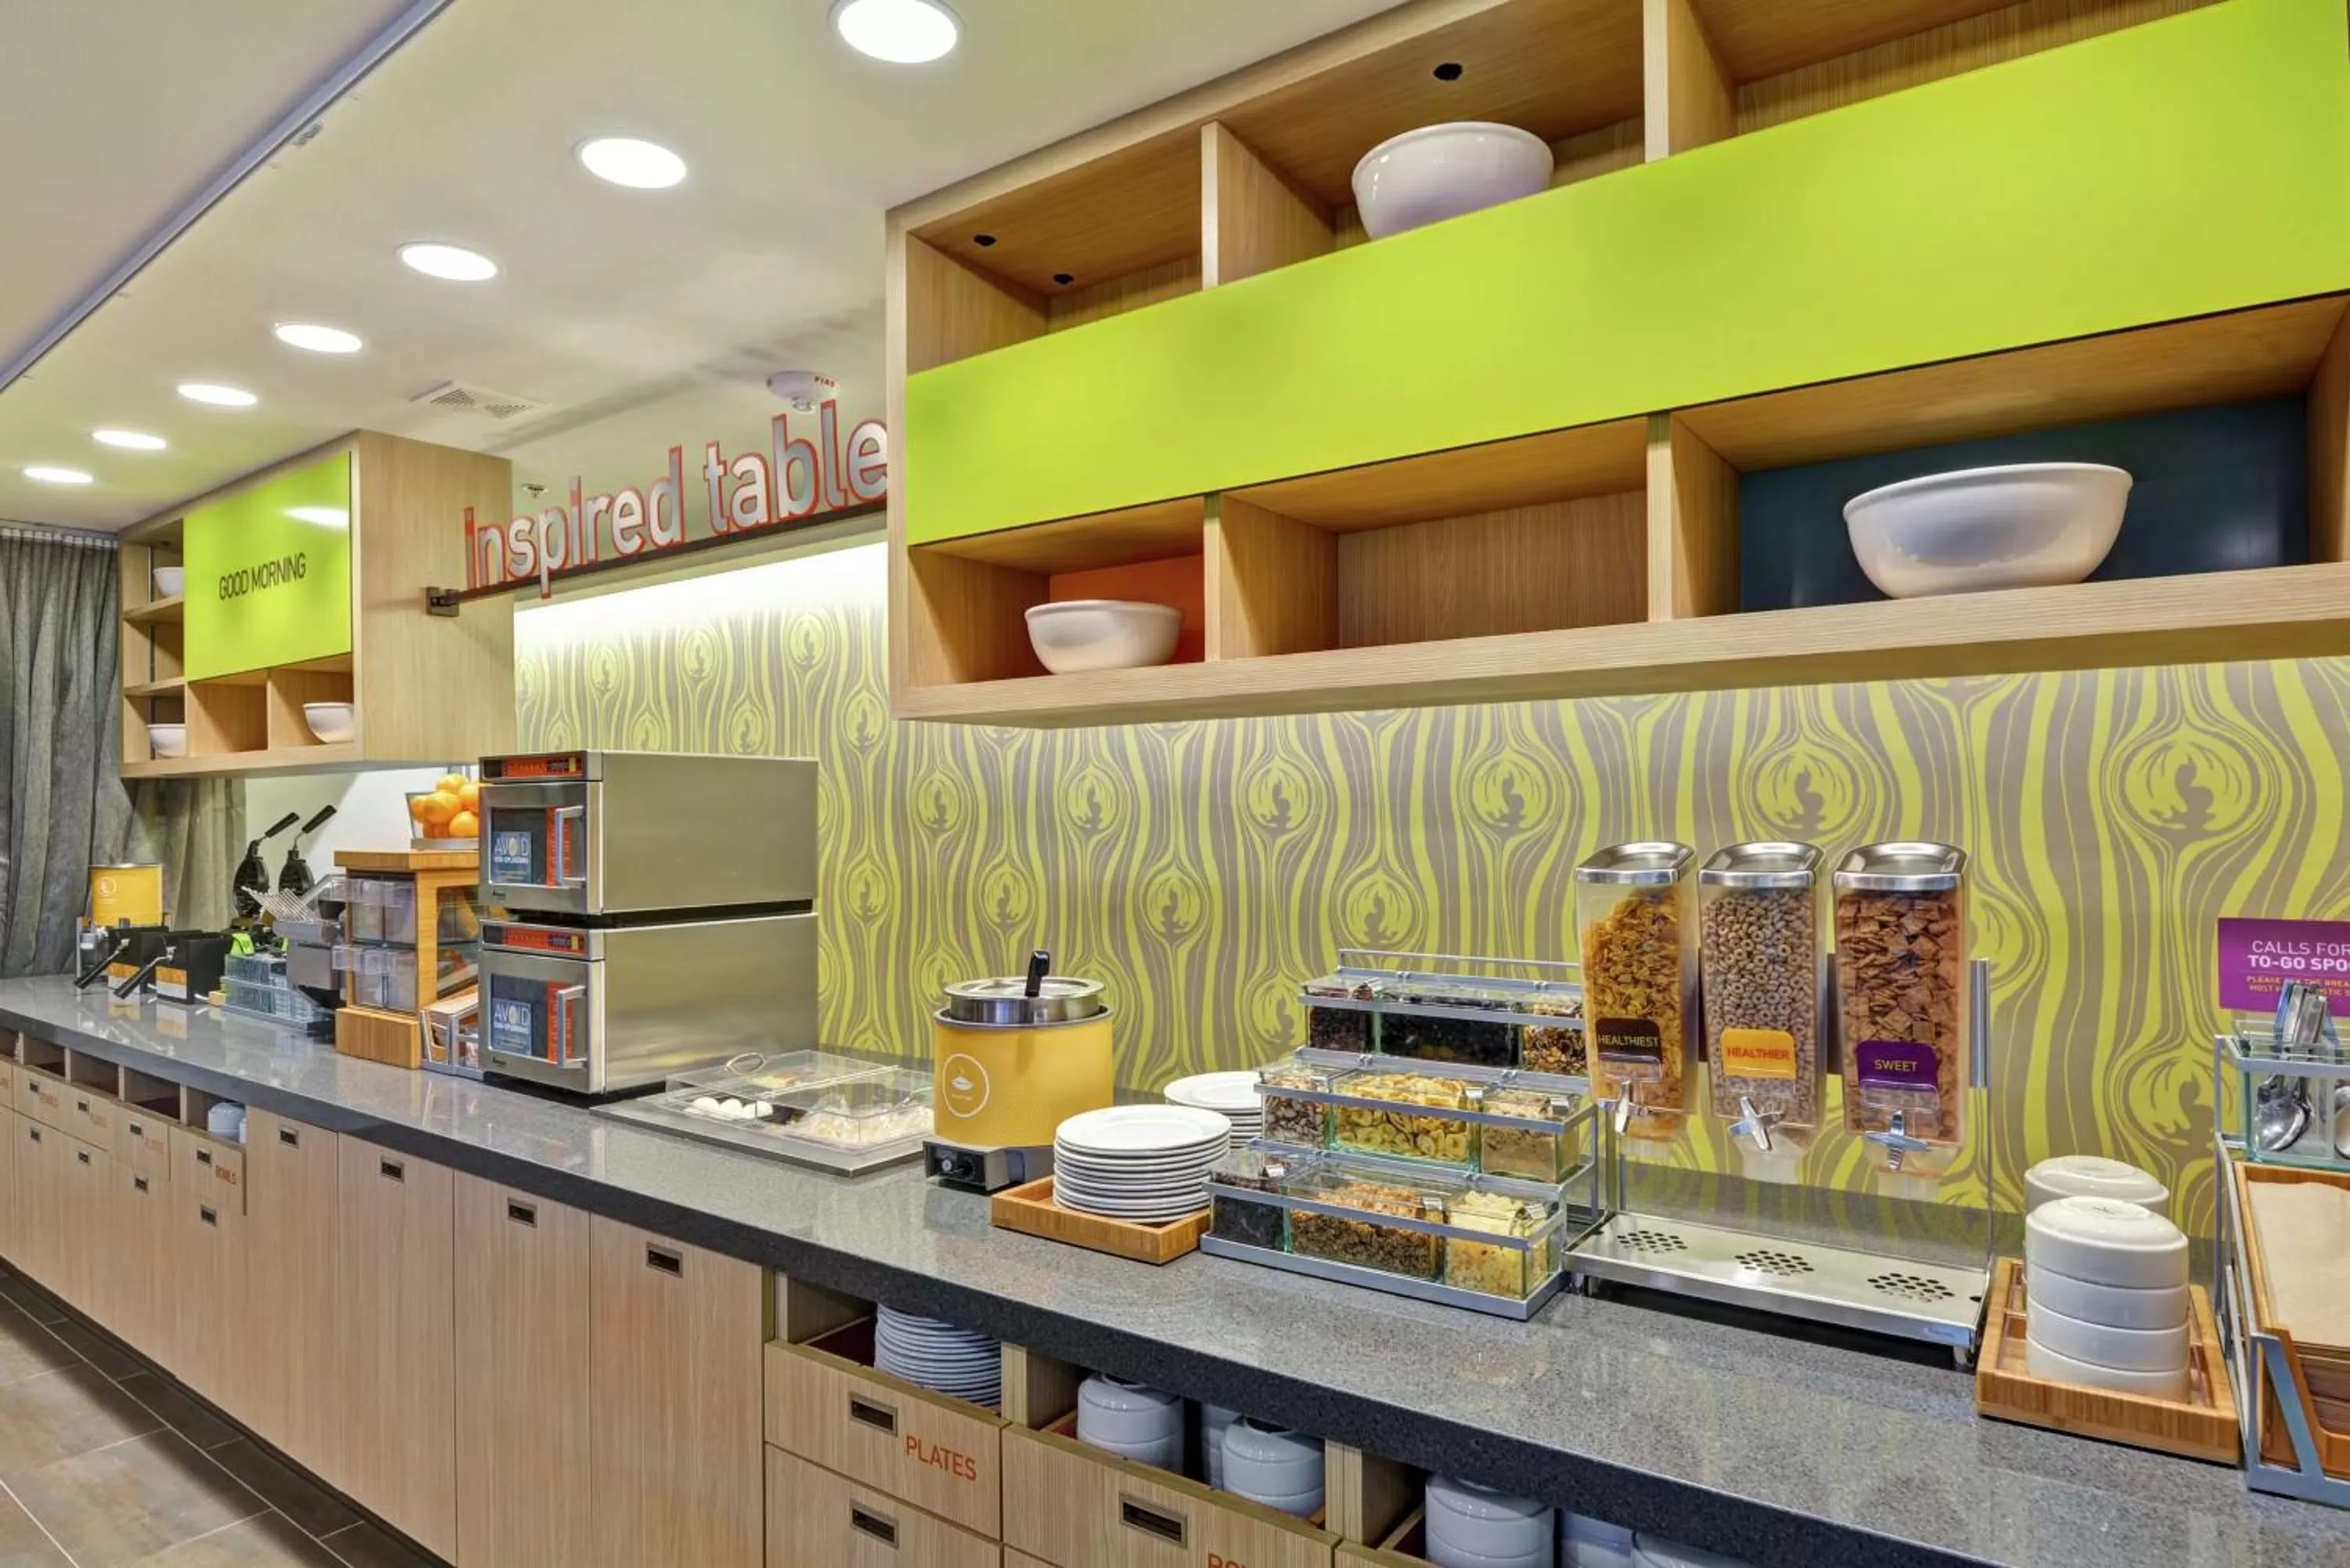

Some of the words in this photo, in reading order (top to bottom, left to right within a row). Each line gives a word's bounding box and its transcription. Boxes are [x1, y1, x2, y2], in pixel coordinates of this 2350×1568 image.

[464, 444, 685, 599] inspired
[703, 399, 888, 534] table
[219, 569, 249, 601] GOOD
[251, 551, 306, 592] MORNING
[2252, 940, 2310, 956] CALLS
[2247, 954, 2305, 970] TO-GO
[2310, 957, 2350, 972] SPO
[1598, 1034, 1658, 1047] HEALTHIEST
[1726, 1046, 1790, 1060] HEALTHIER
[1874, 1059, 1918, 1072] SWEET
[906, 1433, 977, 1482] PLATES
